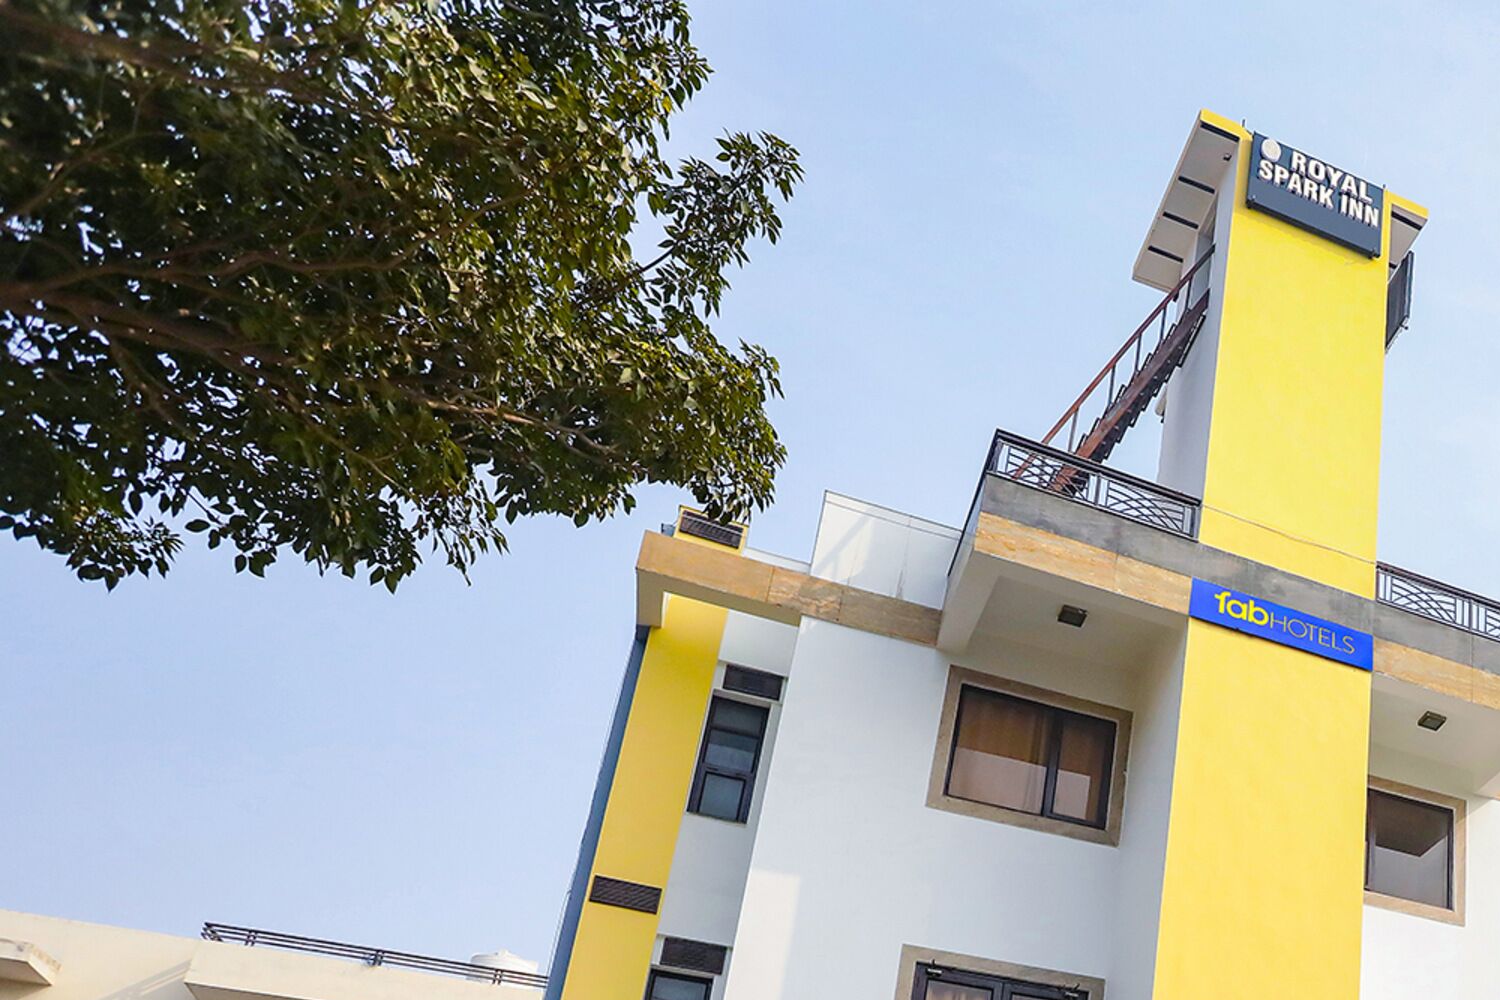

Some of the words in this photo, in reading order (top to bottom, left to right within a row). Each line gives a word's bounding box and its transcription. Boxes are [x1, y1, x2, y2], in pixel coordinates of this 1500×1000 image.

[1258, 160, 1334, 210] SPARK
[1339, 194, 1379, 228] INN
[1291, 150, 1373, 204] ROYAL
